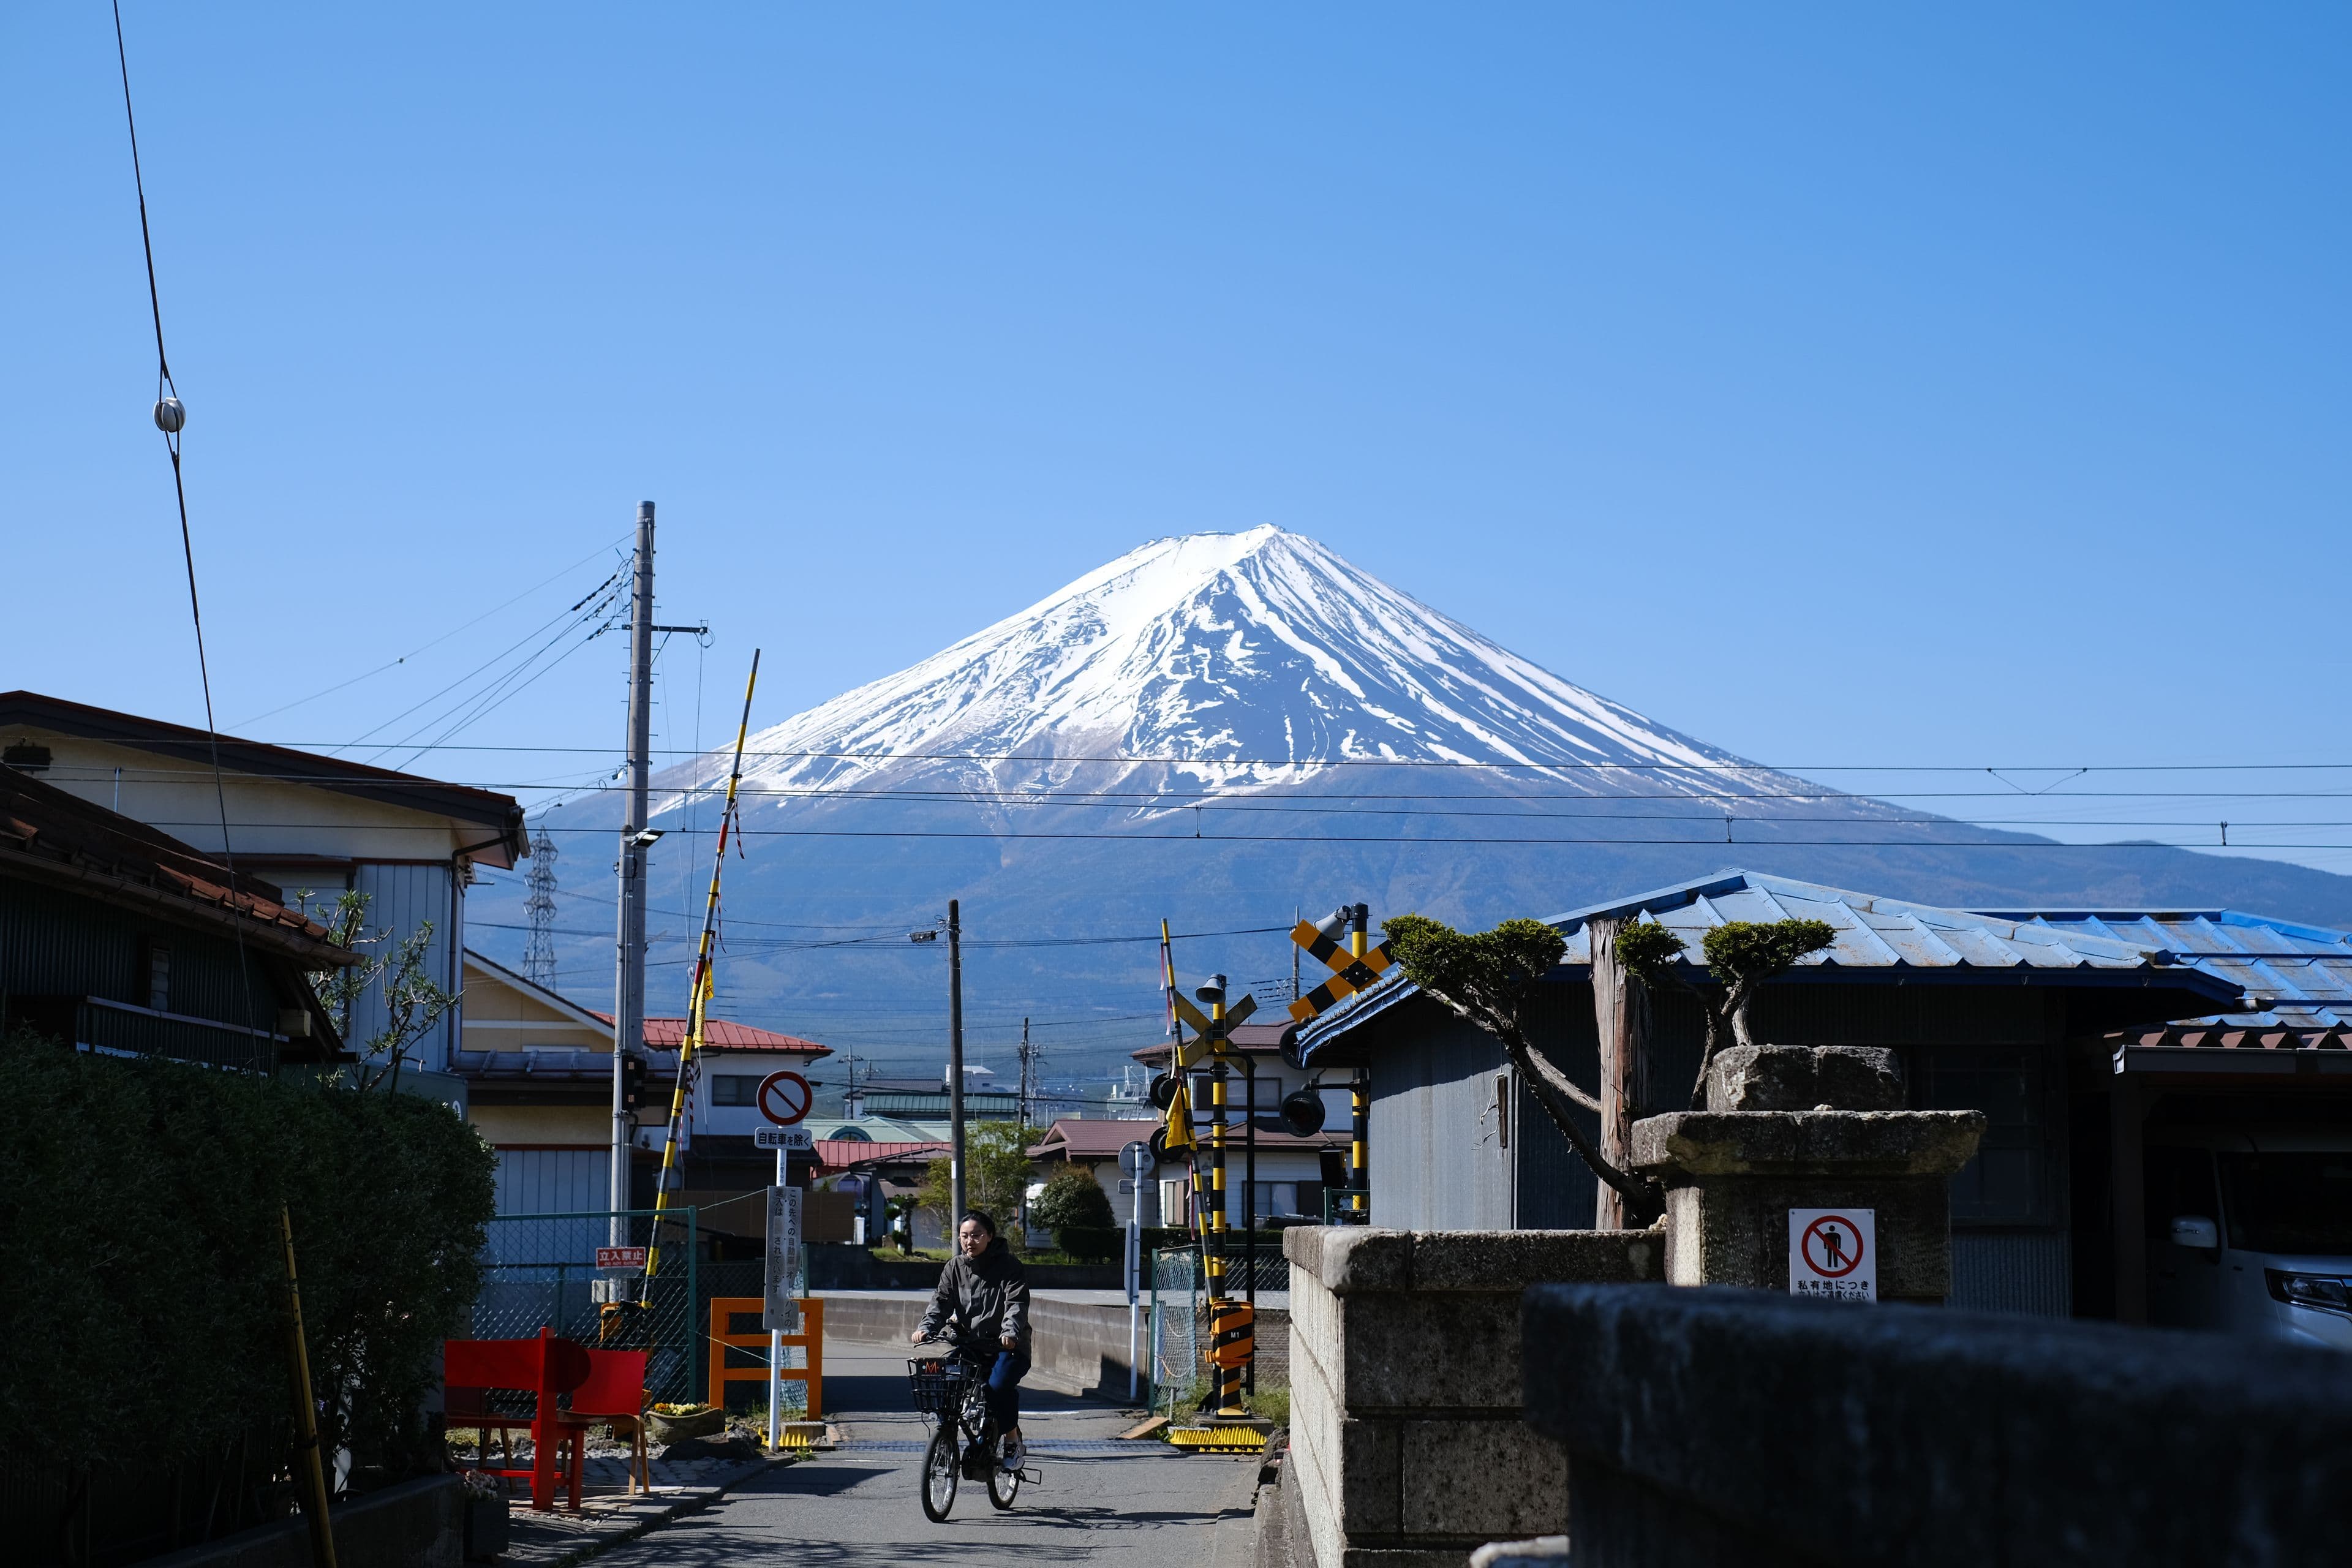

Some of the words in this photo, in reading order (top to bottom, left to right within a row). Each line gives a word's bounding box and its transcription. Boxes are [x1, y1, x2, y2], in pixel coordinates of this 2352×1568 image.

[758, 1132, 809, 1147] 自転車を除く
[599, 1251, 643, 1261] 立入禁止
[1797, 1280, 1869, 1290] 私有地につき
